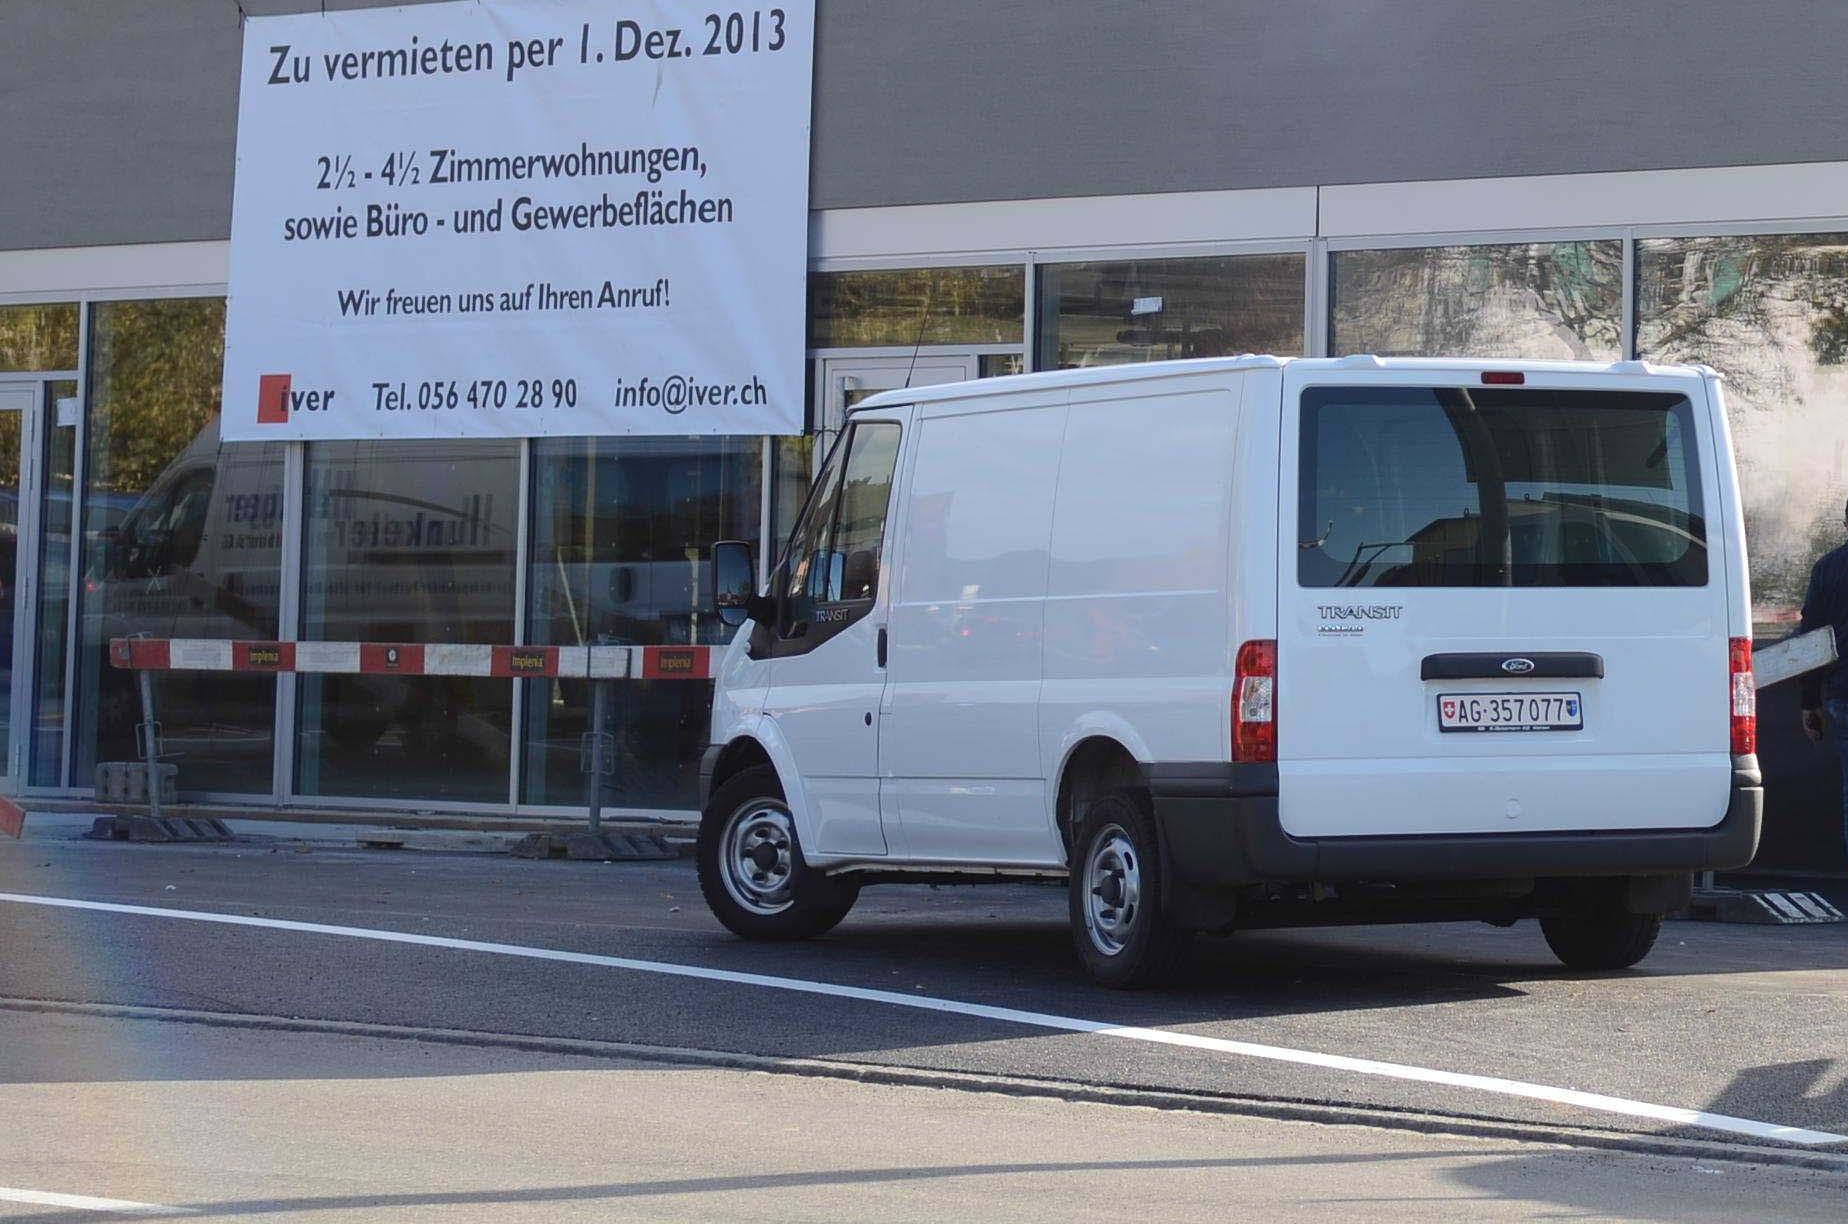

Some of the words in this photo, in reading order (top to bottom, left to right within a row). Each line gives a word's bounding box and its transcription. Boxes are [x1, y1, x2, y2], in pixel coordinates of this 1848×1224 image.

[268, 46, 310, 84] Zu
[324, 36, 494, 80] vermieten
[507, 38, 563, 81] per
[615, 21, 692, 62] Dez.
[702, 9, 786, 56] 2013
[429, 142, 707, 183] Zimmerwohnungen,
[284, 204, 357, 241] sowie
[367, 203, 428, 237] Büro
[452, 198, 501, 233] und
[510, 190, 733, 233] Gewerbeflächen
[338, 288, 380, 317] Wir
[385, 287, 451, 315] freuen
[459, 289, 494, 313] uns
[499, 283, 534, 312] auf
[538, 281, 593, 310] Ihren
[597, 279, 670, 309] Anruf!
[280, 383, 335, 413] iver
[372, 381, 411, 411] Tel.
[418, 381, 457, 410] 056
[467, 380, 507, 410] 470
[514, 379, 544, 410] 28
[551, 378, 577, 409] 90
[614, 374, 766, 415] info@iver.ch
[1317, 605, 1403, 619] TRANSIT
